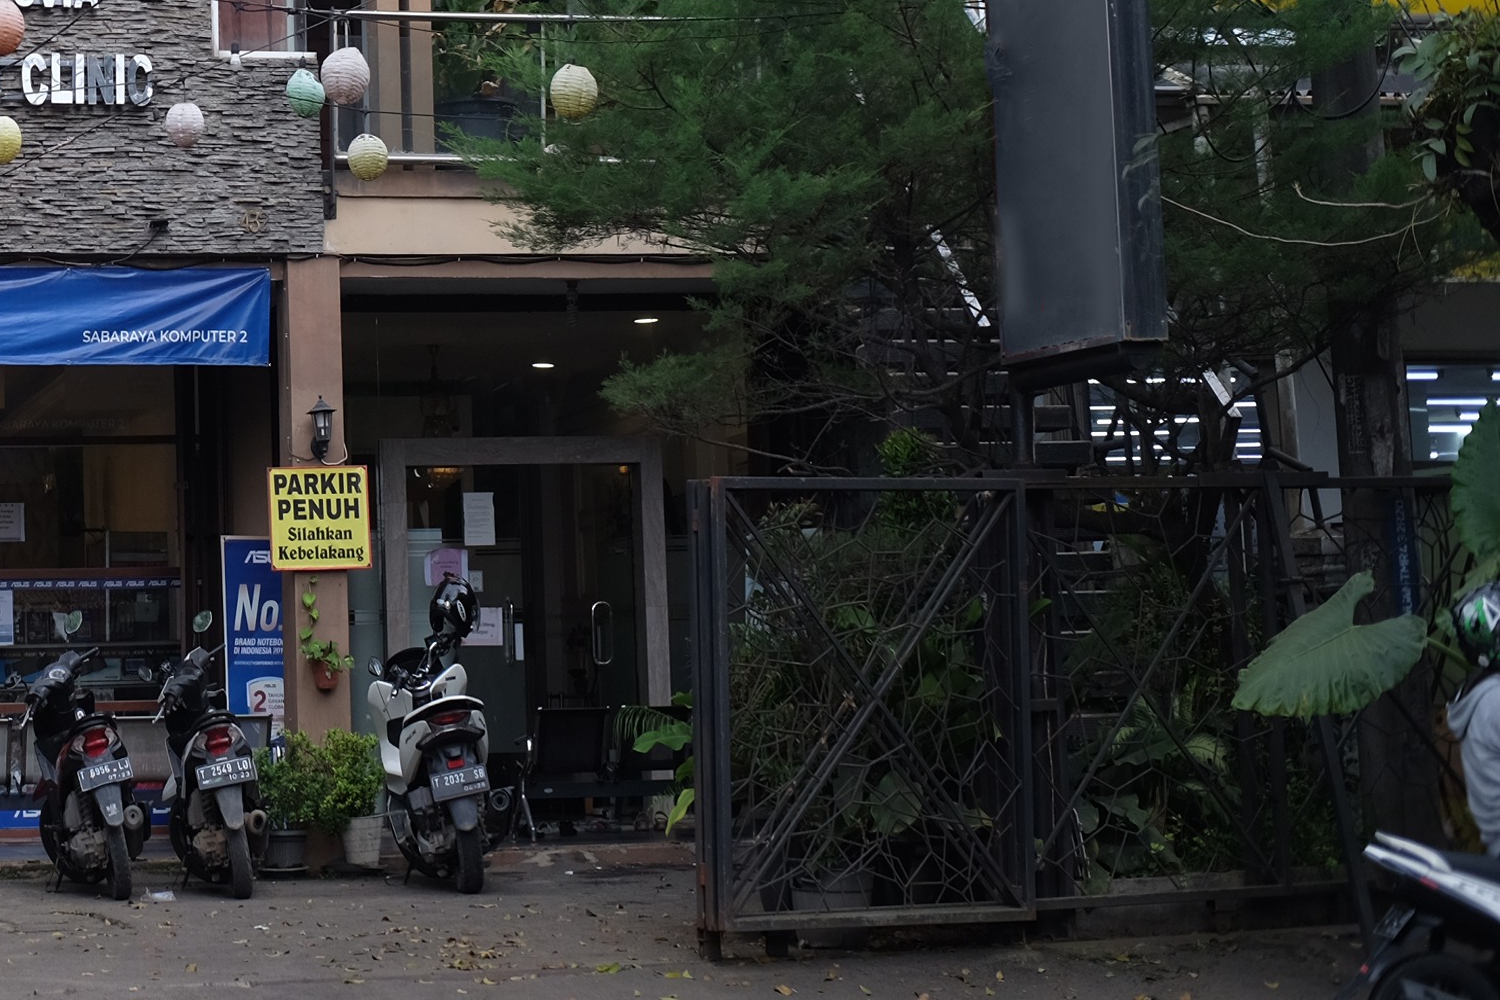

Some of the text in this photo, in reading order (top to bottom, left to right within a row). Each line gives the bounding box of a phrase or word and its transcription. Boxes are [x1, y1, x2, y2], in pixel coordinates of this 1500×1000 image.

[21, 52, 154, 107] CLINIC
[82, 330, 248, 343] SABARAYA KOMPUTER 2
[273, 472, 362, 495] PARKIR
[278, 498, 360, 520] PENUH
[287, 526, 353, 541] Silahkan
[278, 546, 364, 562] Kebelakang
[234, 584, 283, 631] No.
[234, 638, 256, 646] BRAND
[253, 690, 267, 712] 2
[210, 762, 232, 777] 2549
[443, 772, 466, 786] 2032
